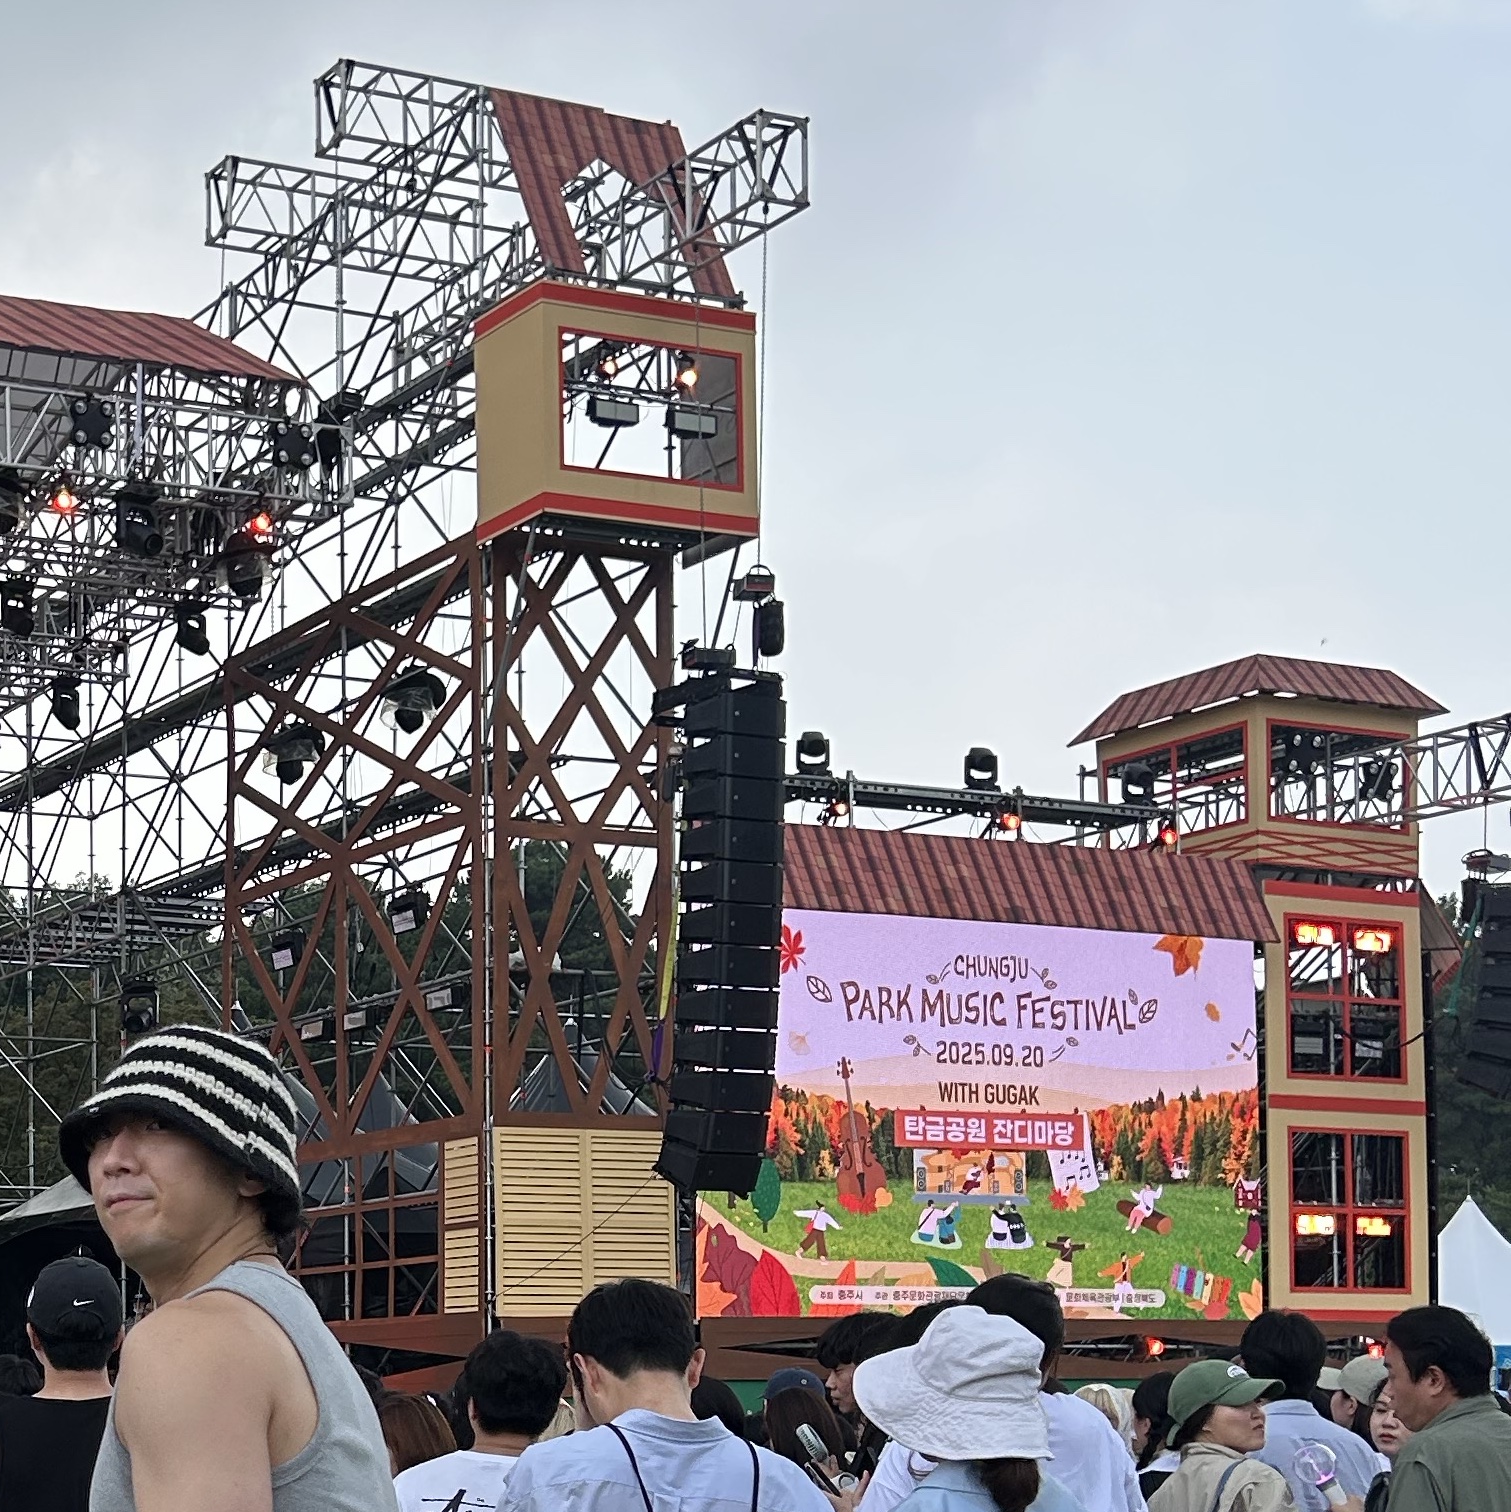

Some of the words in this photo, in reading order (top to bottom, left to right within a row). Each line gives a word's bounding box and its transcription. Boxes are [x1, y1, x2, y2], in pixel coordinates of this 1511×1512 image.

[953, 954, 1030, 984] CHUNGJU
[839, 980, 912, 1025] PARK
[920, 988, 1007, 1028] MUSIC
[1016, 990, 1137, 1036] FESTIVAL
[936, 1040, 1045, 1067] 2025.09.20
[938, 1080, 980, 1104] WITH
[984, 1082, 1040, 1106] GUGAK
[903, 1114, 986, 1145] 탄금공원
[993, 1118, 1075, 1147] 잔디마당
